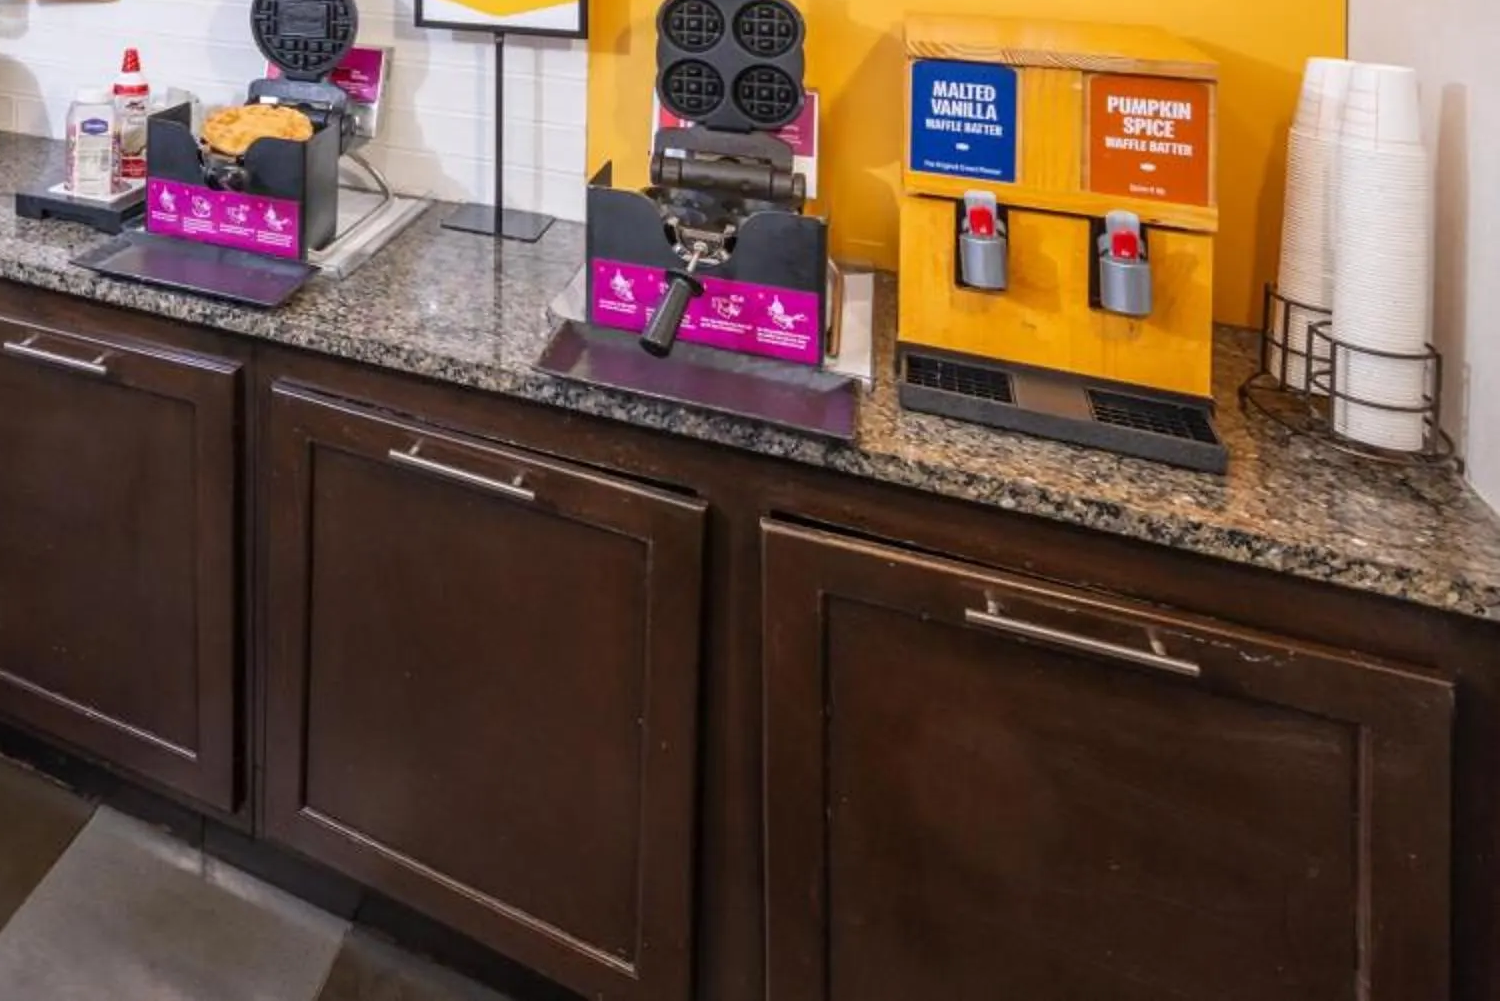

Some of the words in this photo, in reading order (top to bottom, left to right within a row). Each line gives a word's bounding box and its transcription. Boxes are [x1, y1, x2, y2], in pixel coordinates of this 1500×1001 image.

[932, 79, 996, 103] MALTED
[930, 97, 998, 122] VANILLA
[1106, 94, 1192, 121] PUMPKIN
[924, 118, 961, 133] WAFFLE
[963, 121, 1003, 137] BATTER
[1122, 116, 1176, 139] SPICE
[1104, 136, 1148, 153] WAFFLE
[1149, 140, 1194, 157] BATTER
